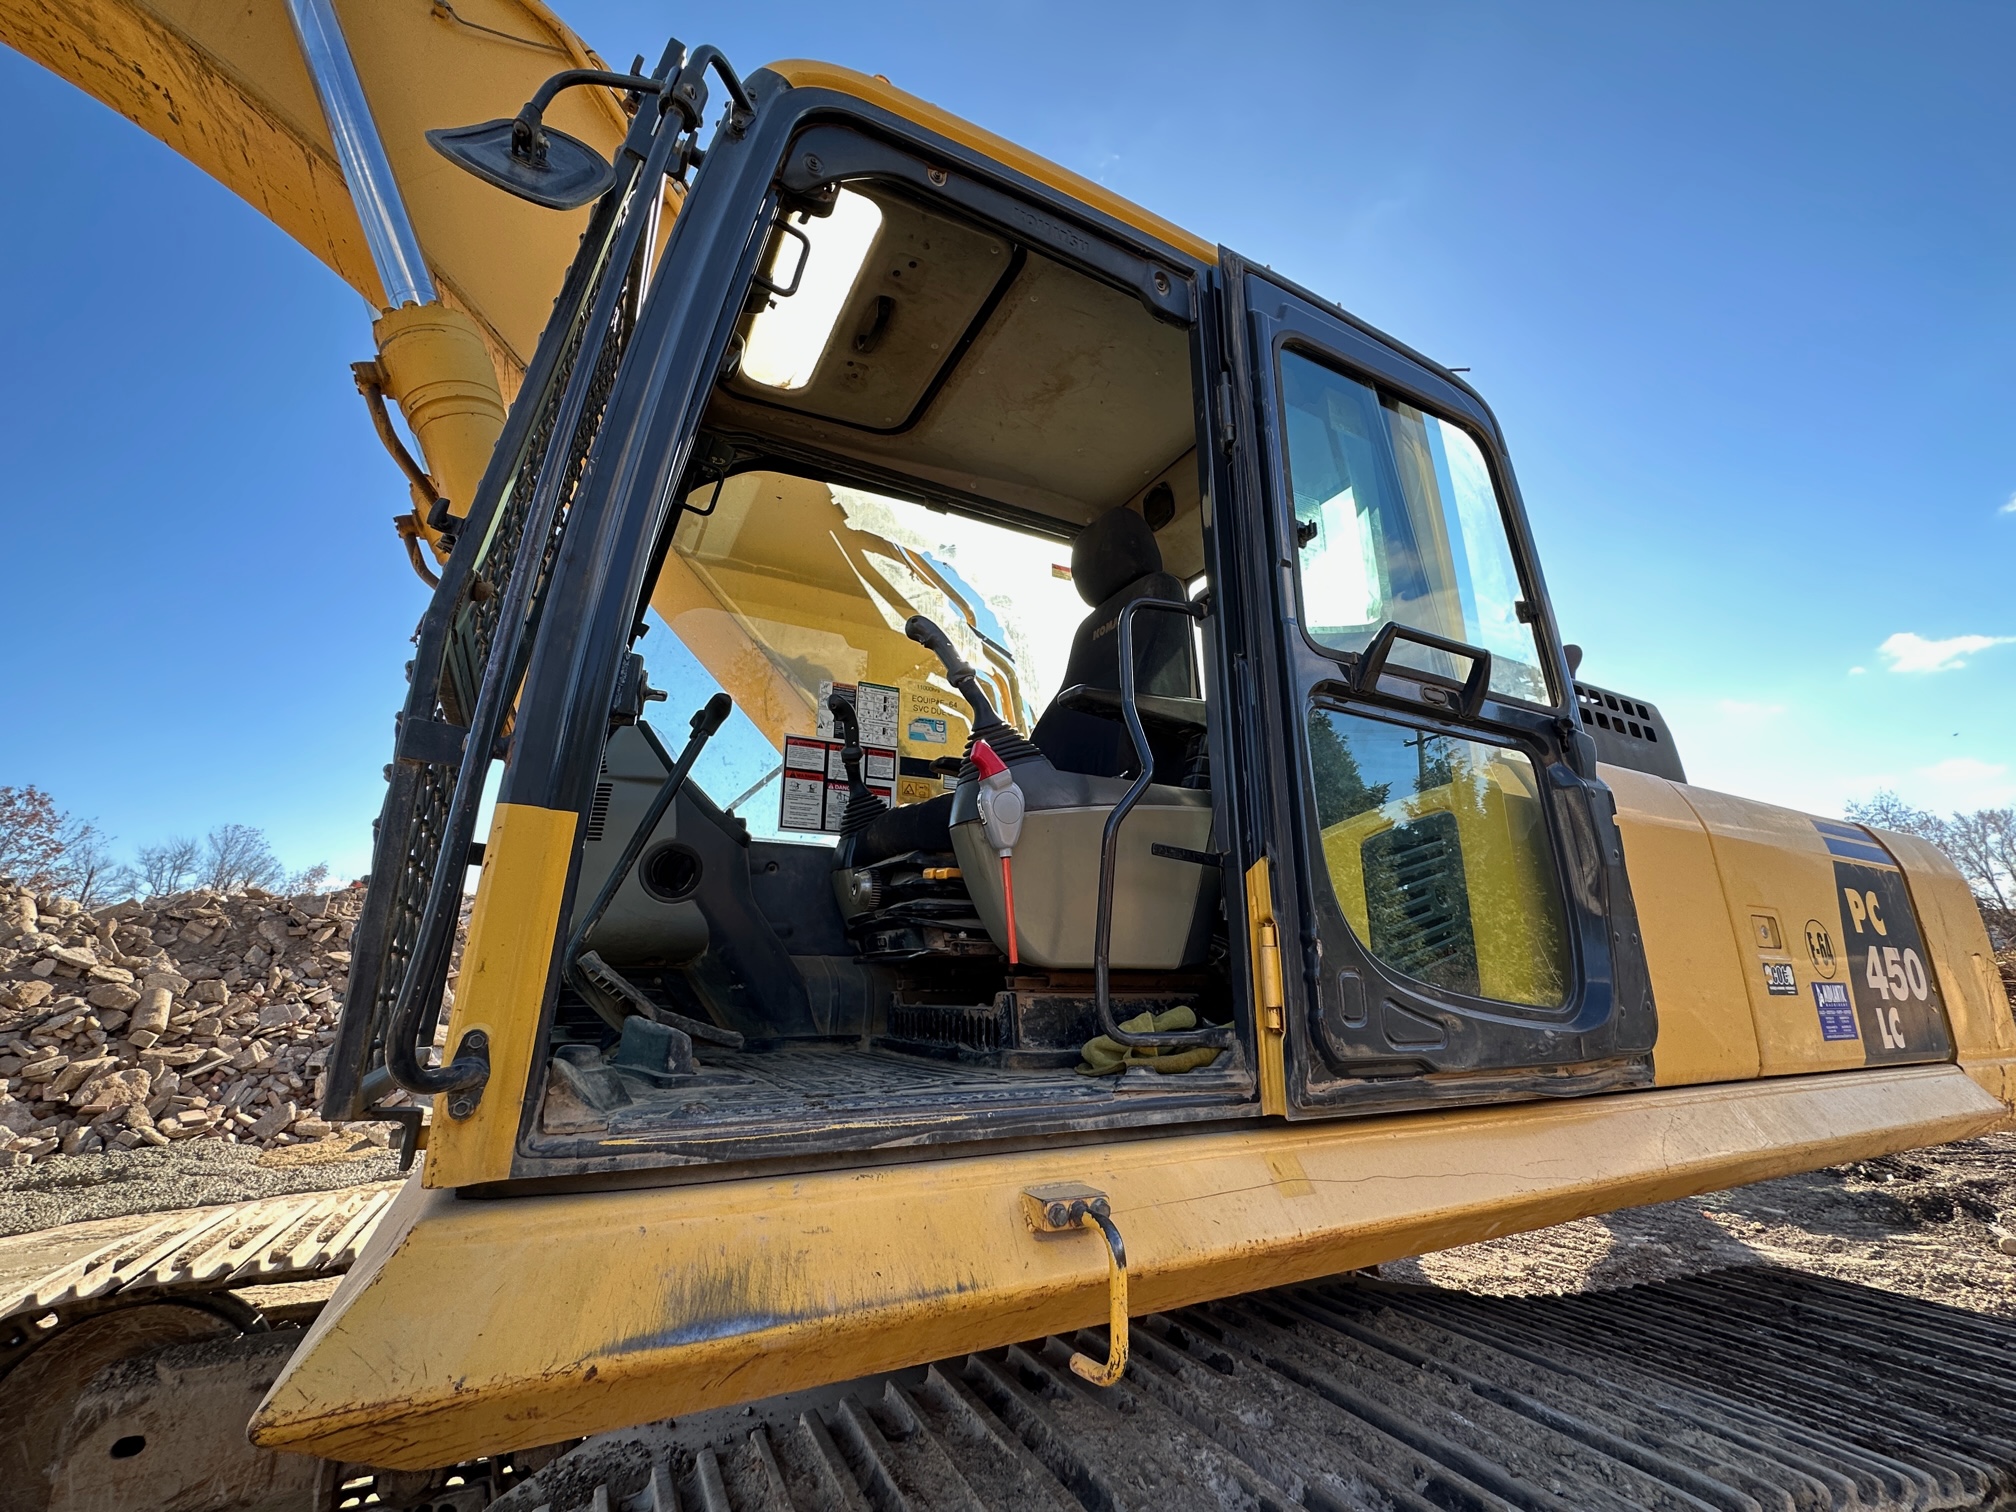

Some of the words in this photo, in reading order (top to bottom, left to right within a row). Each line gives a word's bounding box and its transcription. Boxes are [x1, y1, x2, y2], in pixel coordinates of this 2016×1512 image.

[912, 704, 929, 713] SVC
[1844, 887, 1887, 936] PC
[1866, 945, 1928, 1001] 450
[1875, 1006, 1906, 1049] LC
